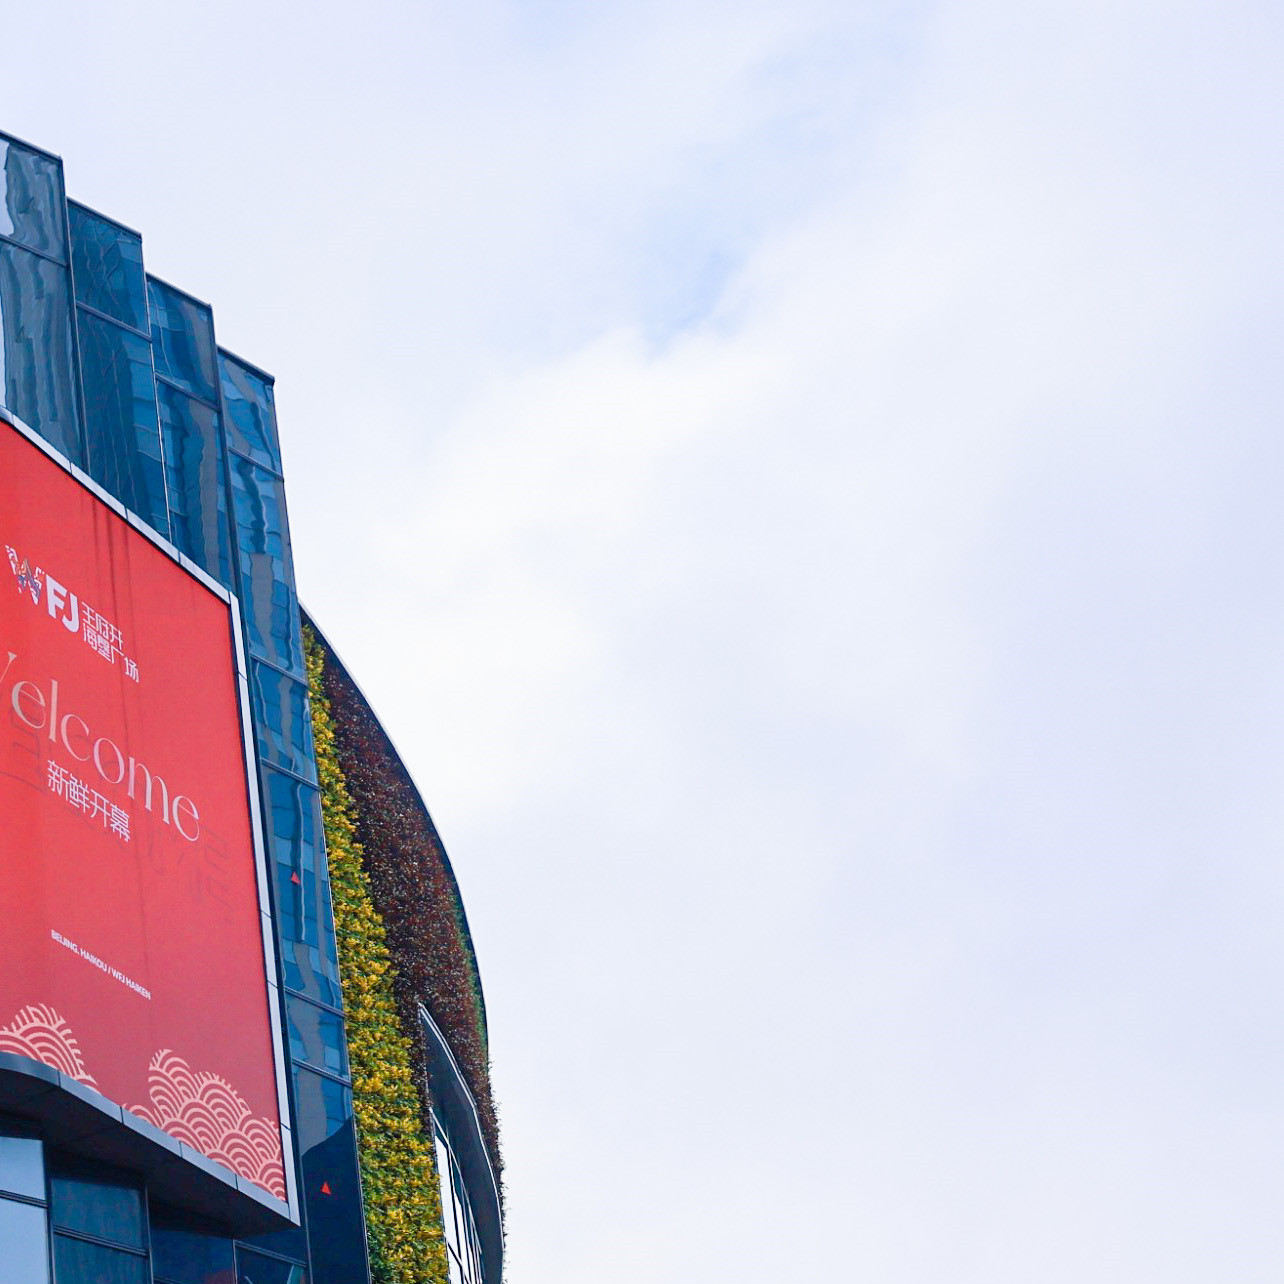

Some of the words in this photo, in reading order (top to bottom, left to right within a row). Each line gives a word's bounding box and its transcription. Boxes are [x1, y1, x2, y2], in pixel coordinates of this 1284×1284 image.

[5, 545, 81, 633] WFJ
[47, 760, 131, 842] 新鲜开幕
